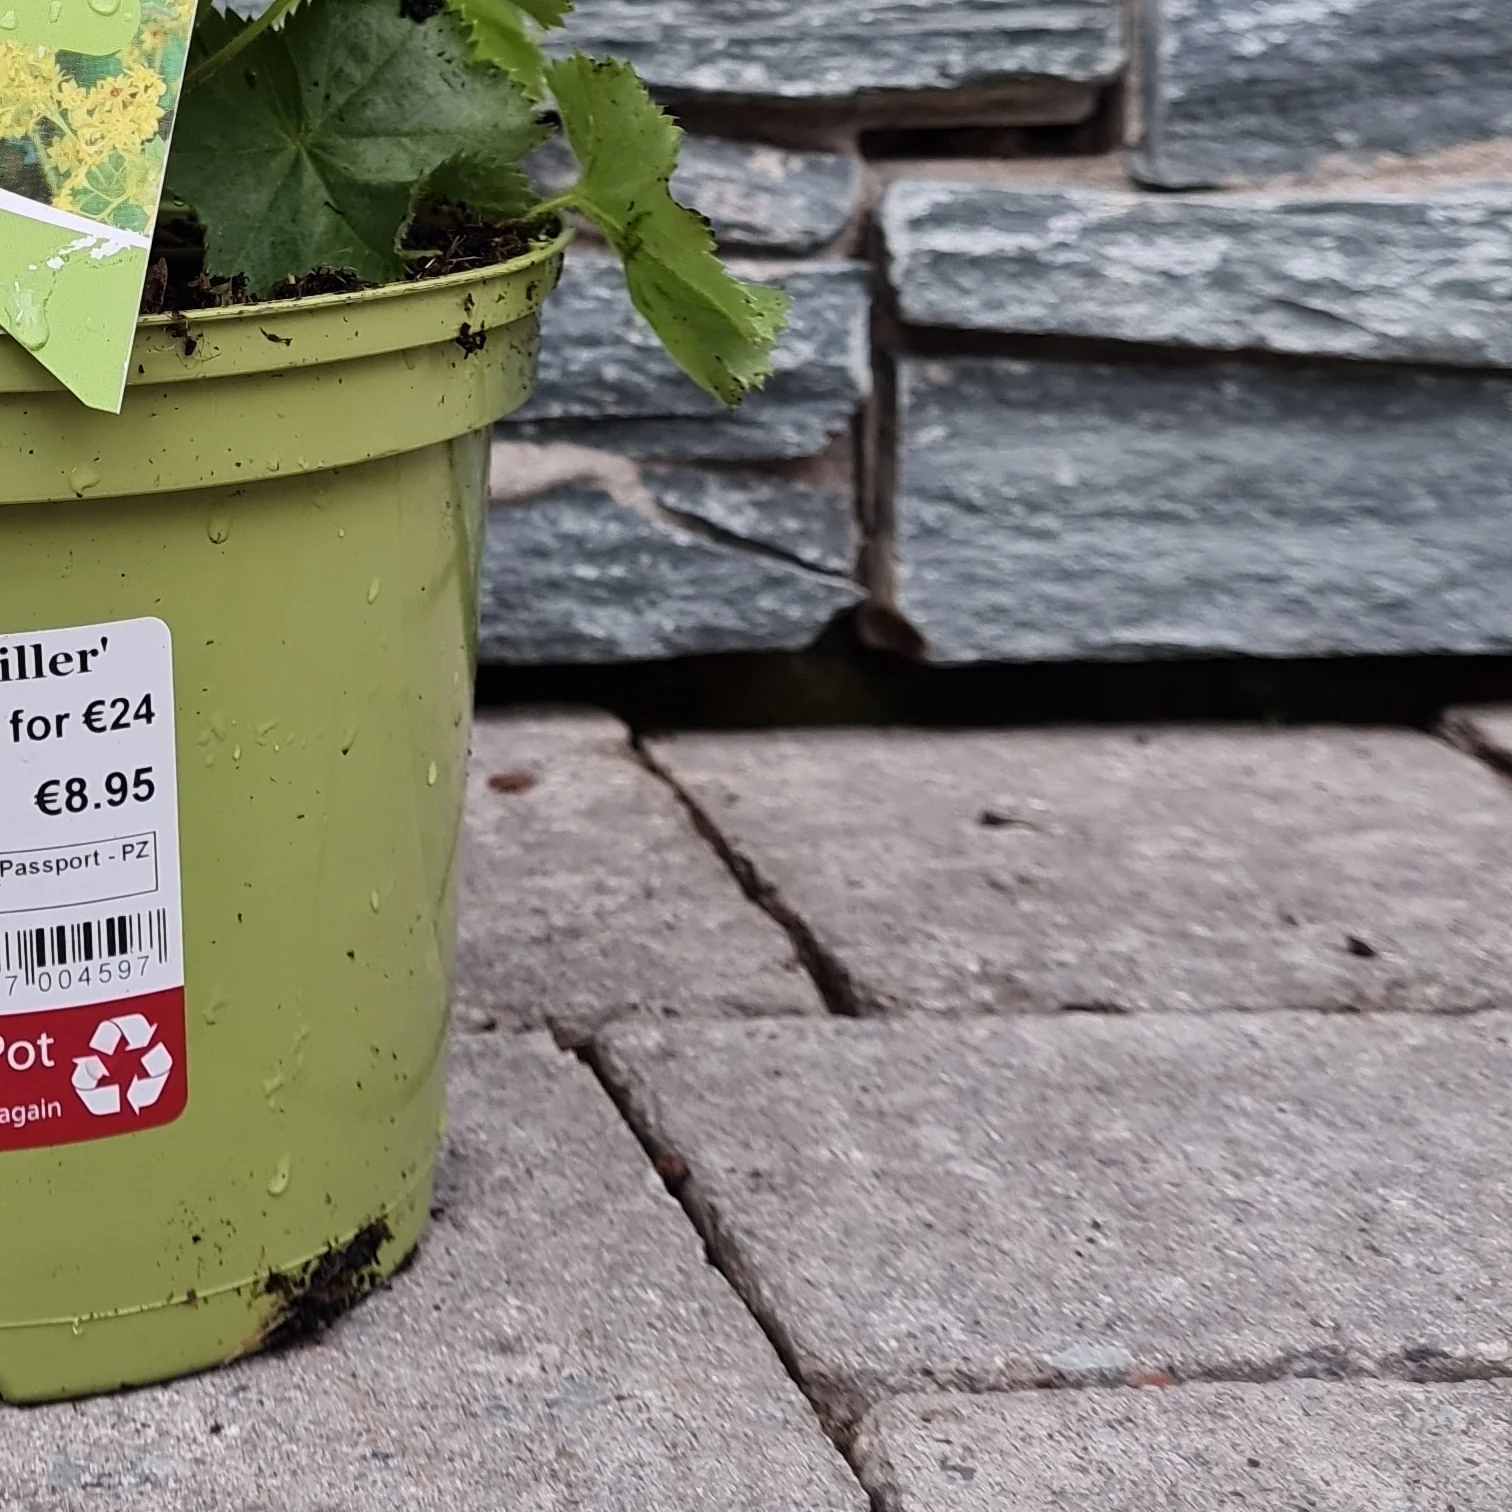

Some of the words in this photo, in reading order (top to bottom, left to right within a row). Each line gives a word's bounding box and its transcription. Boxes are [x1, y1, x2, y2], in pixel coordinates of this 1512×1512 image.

[9, 709, 70, 743] for
[81, 692, 155, 734] €24
[33, 766, 155, 816] €8.95
[0, 849, 101, 879] Passport
[121, 840, 150, 863] PZ
[38, 955, 150, 993] 004597
